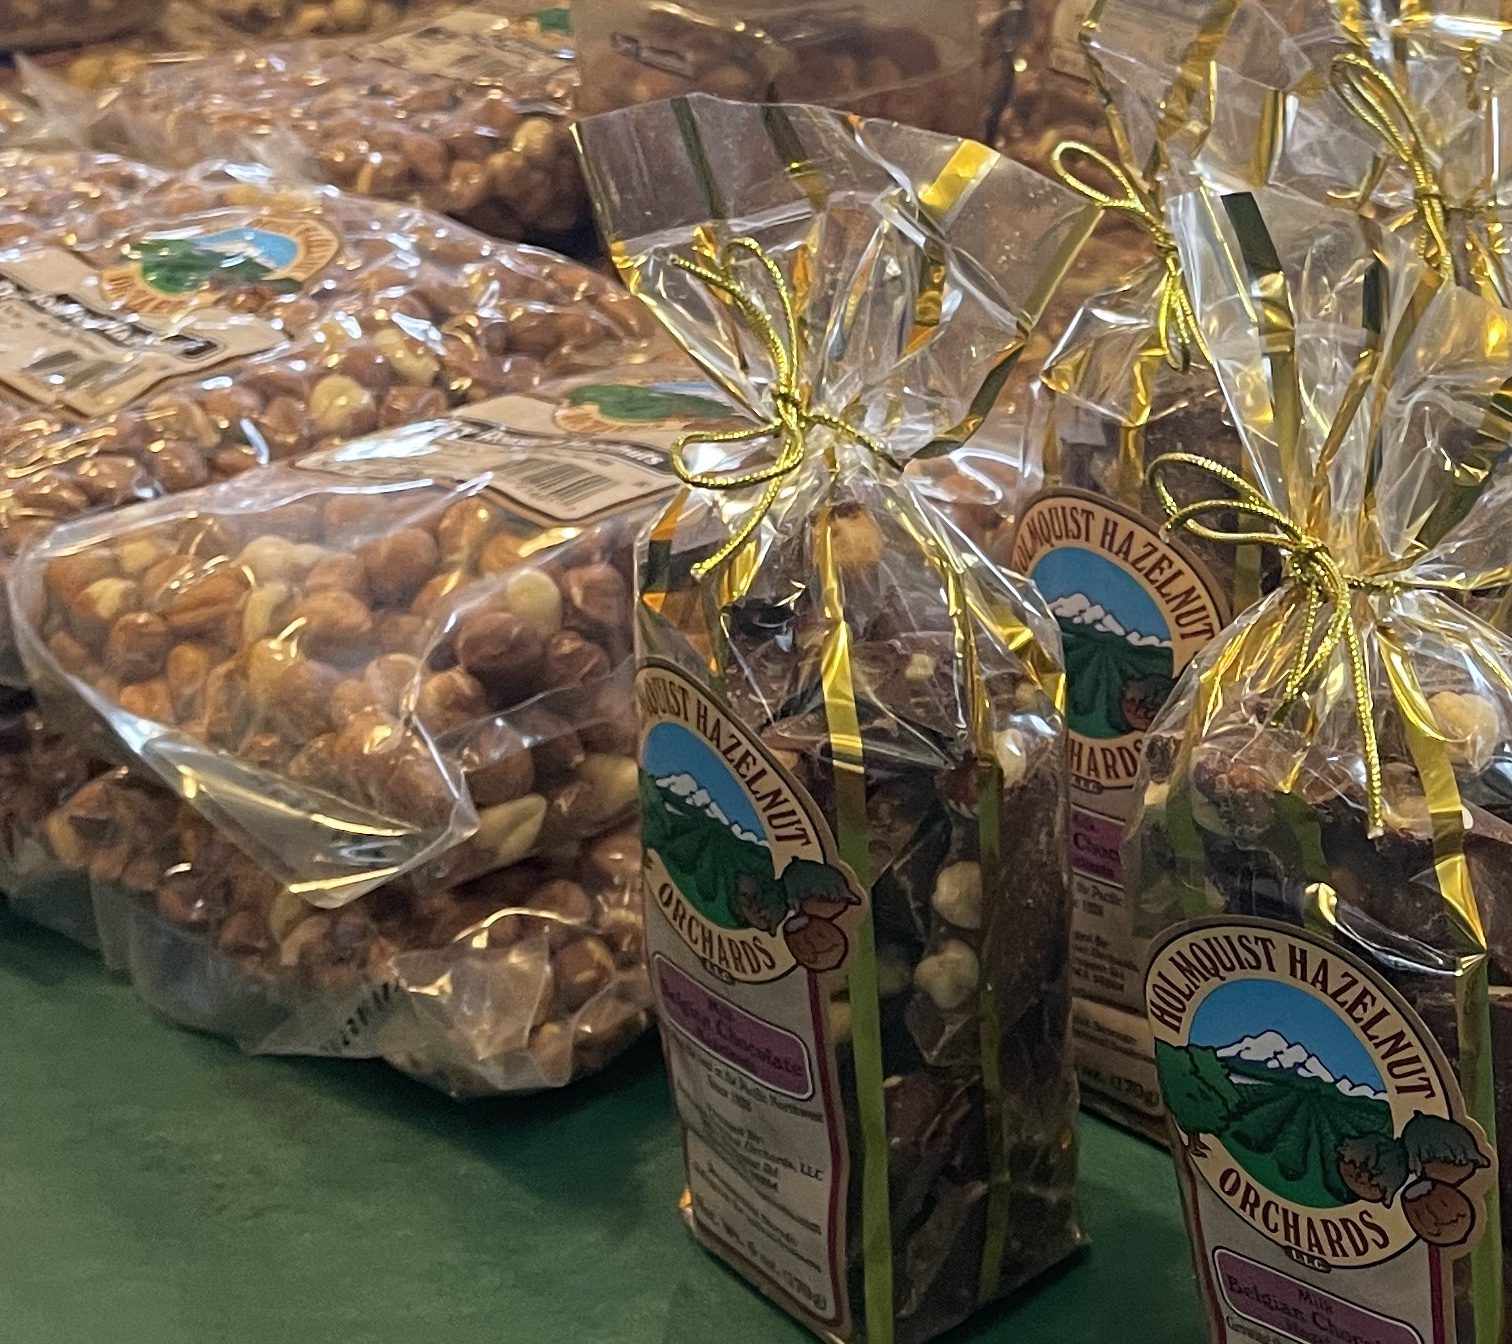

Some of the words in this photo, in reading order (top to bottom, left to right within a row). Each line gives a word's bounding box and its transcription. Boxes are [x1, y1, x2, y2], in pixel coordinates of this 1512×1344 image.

[1015, 505, 1094, 573] OLMQUIST
[1101, 517, 1214, 642] HAZELNUT
[645, 675, 689, 721] QUIST
[696, 699, 812, 855] HAZELNUT
[1069, 737, 1143, 780] HARDS
[658, 882, 776, 975] ORCHARDS
[1150, 933, 1277, 1034] HOLMQUIST
[1288, 942, 1436, 1100] HAZELNUT
[1218, 1167, 1390, 1259] ORCHARDS
[1225, 1274, 1306, 1323] Belgian
